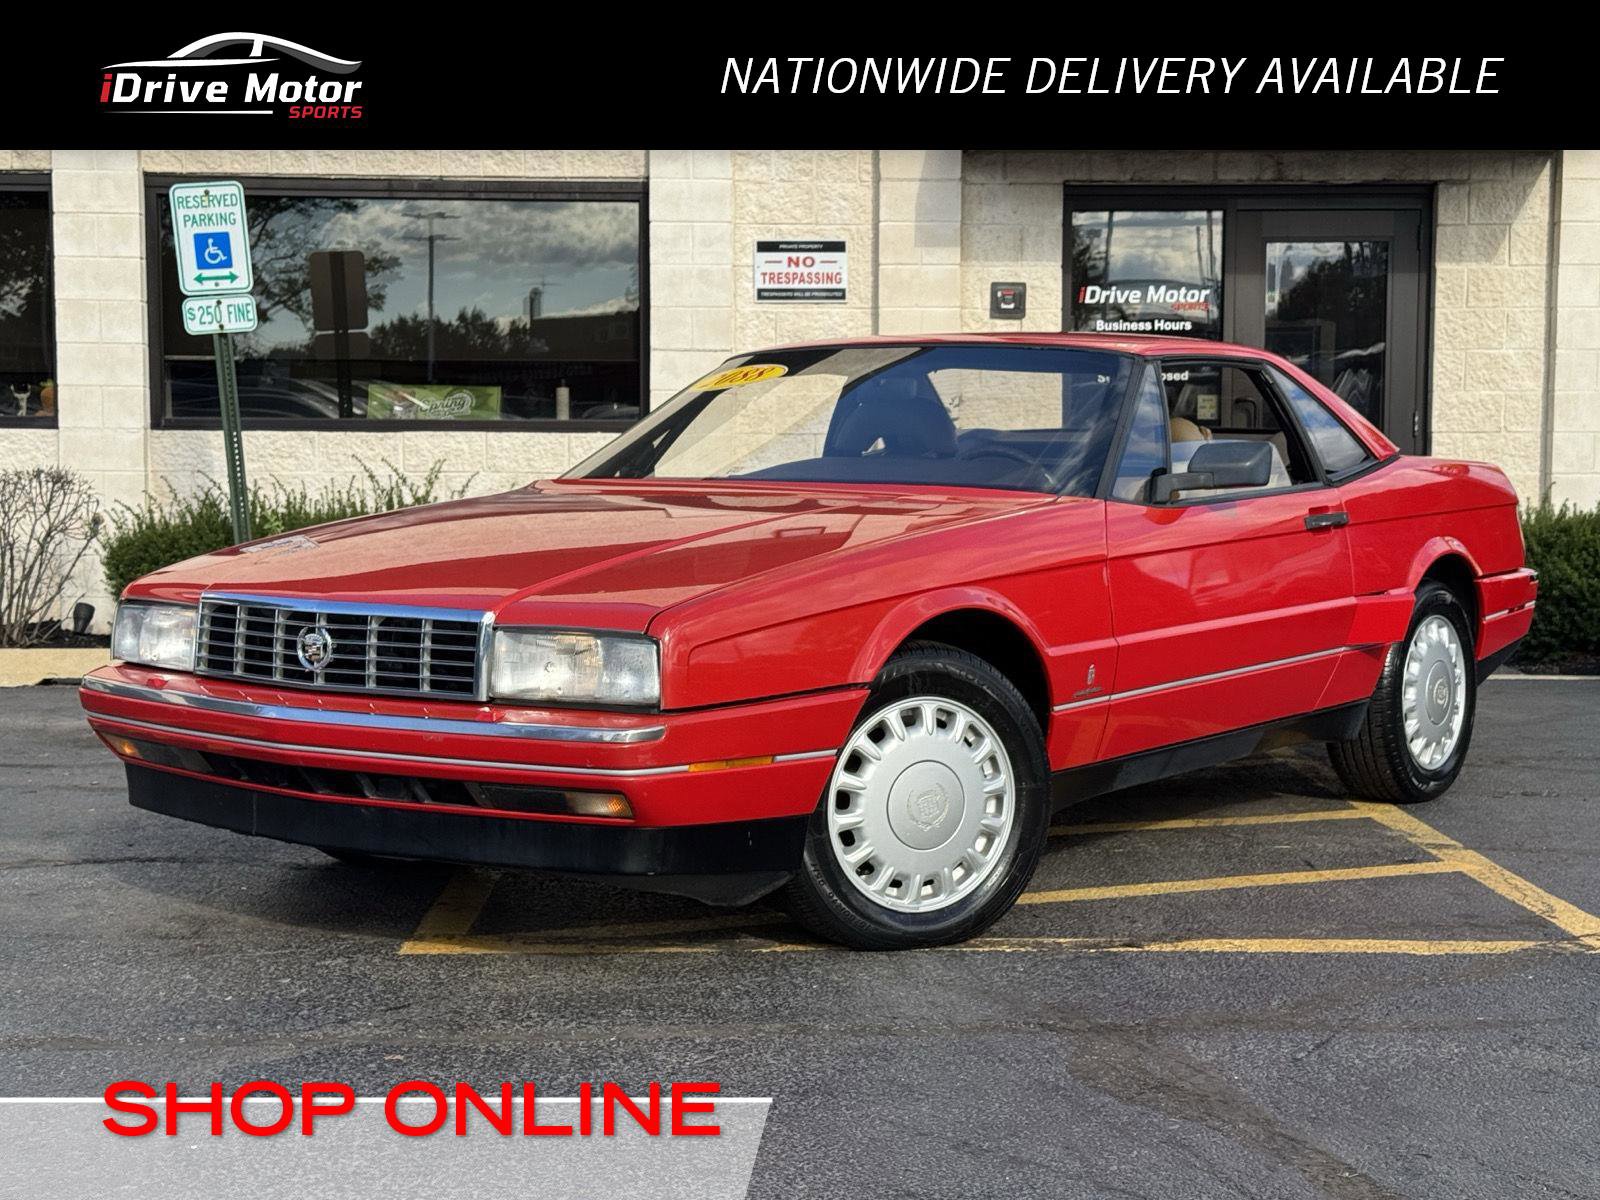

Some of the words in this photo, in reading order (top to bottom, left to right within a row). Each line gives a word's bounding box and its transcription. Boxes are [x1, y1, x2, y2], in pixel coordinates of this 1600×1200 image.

[177, 193, 239, 210] RESERVED
[183, 211, 237, 228] PARKING
[787, 255, 816, 269] NO
[760, 271, 843, 286] TRESPASSING
[1146, 284, 1211, 304] Motor
[187, 304, 223, 326] $250
[227, 302, 254, 324] FINE
[1096, 320, 1152, 332] Business
[1153, 319, 1193, 332] Hours
